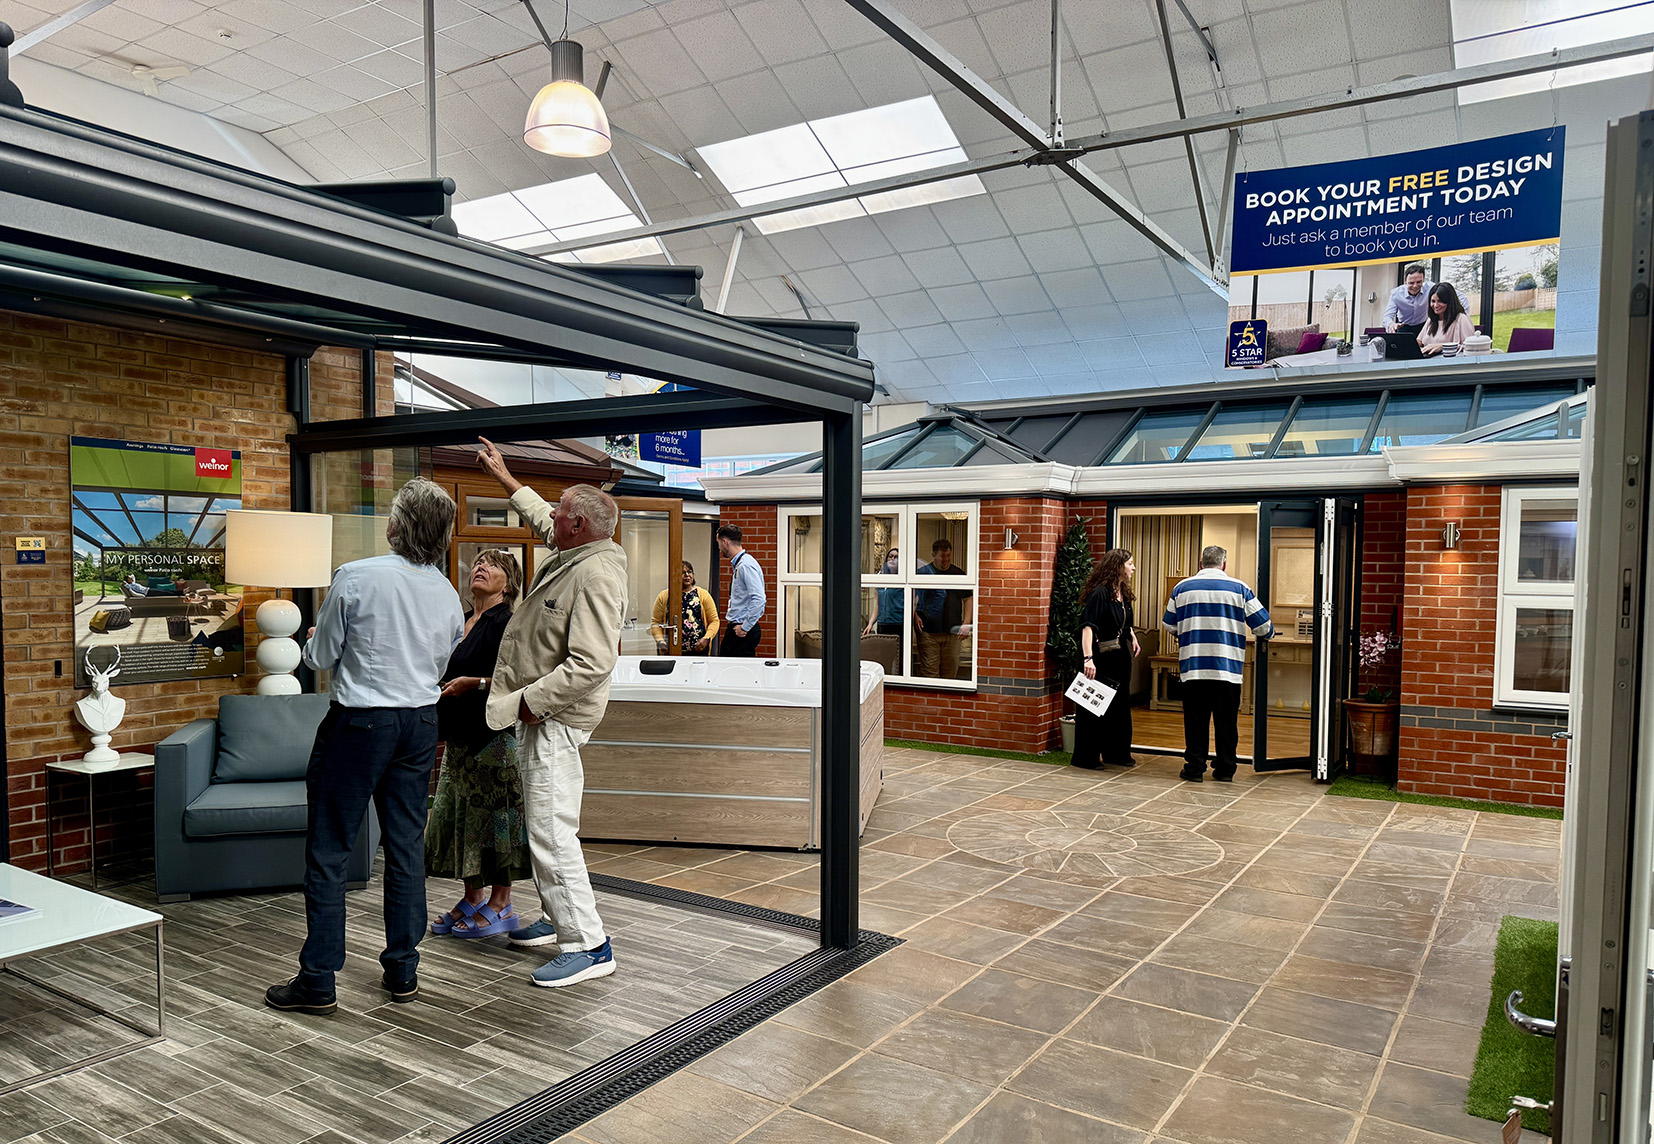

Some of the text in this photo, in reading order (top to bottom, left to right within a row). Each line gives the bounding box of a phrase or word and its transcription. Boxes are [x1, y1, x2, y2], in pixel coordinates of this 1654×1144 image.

[1246, 152, 1553, 209] BOOK YOUR FREE DESIGN
[1265, 177, 1526, 226] APPOINTMENT TODAY
[1262, 207, 1513, 247] Just ask a member of our team
[1325, 232, 1440, 257] to book you in.
[1242, 327, 1255, 345] 5
[1231, 347, 1263, 357] 5 STAR
[655, 434, 679, 445] more for
[655, 443, 660, 452] 6
[199, 458, 229, 471] weinor
[106, 554, 220, 565] MY PERSONAL SPACE
